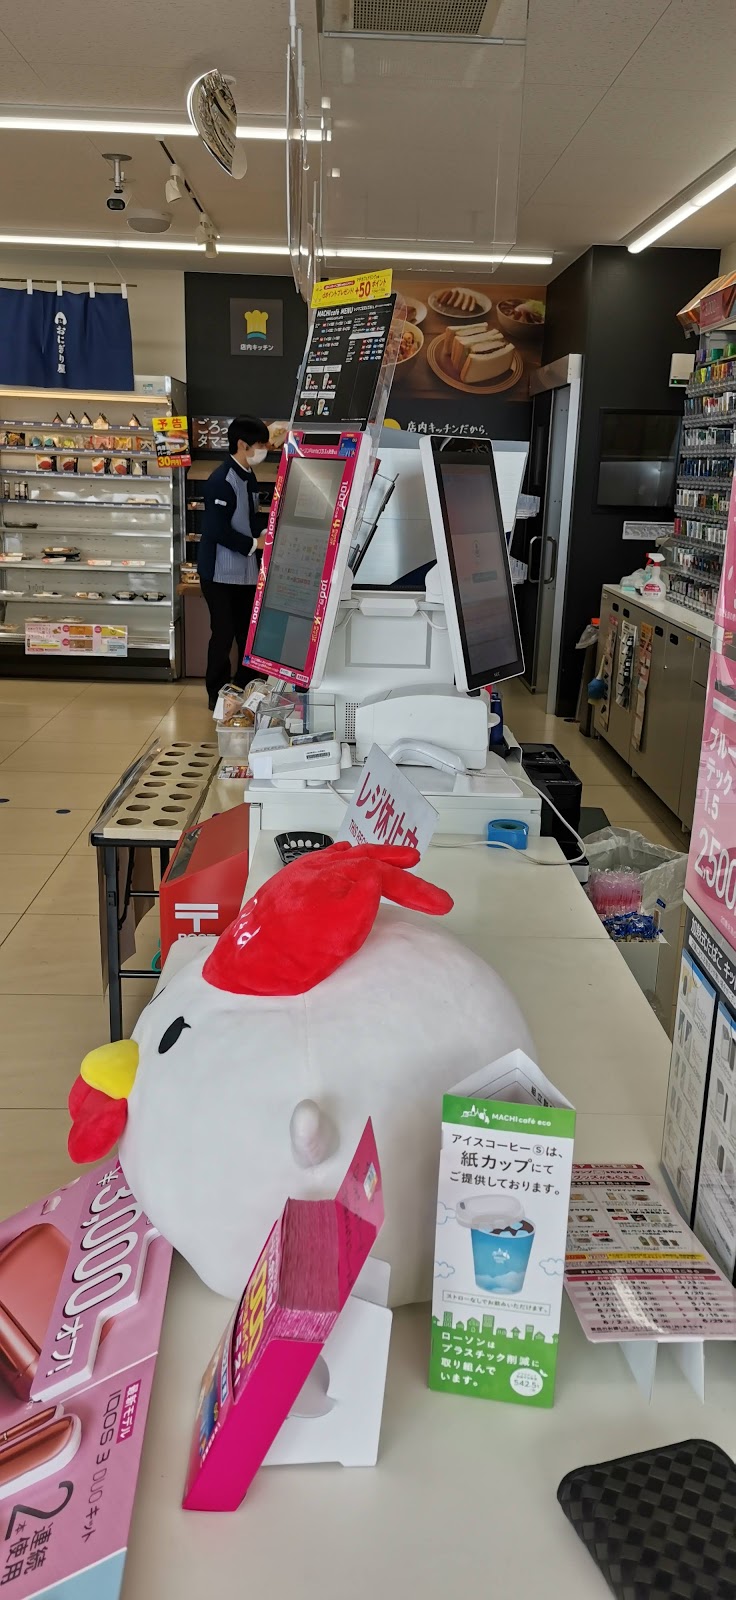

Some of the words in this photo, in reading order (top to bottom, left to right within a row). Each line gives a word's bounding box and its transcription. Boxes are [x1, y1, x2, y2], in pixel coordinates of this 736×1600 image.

[56, 325, 67, 374] おにぎり屋
[240, 343, 274, 351] 店内キッチン
[157, 418, 182, 430] 予告
[704, 786, 720, 821] 1.5
[492, 1113, 518, 1123] MACHI
[518, 1116, 536, 1125] café
[537, 1119, 552, 1127] eco
[460, 1150, 554, 1175] 紙カップにて
[449, 1171, 560, 1196] ご提供しております。
[446, 1292, 549, 1314] ストローなしでお飲みいただけます。
[441, 1331, 496, 1349] ローソンは
[441, 1343, 540, 1368] プラスチック削減に
[441, 1357, 497, 1376] 取り組んで
[440, 1372, 479, 1387] います。
[100, 1389, 122, 1446] IQOS
[119, 1382, 141, 1439] 最新モデル
[96, 1449, 110, 1465] 3
[88, 1467, 108, 1504] DUO
[82, 1506, 100, 1543] キット
